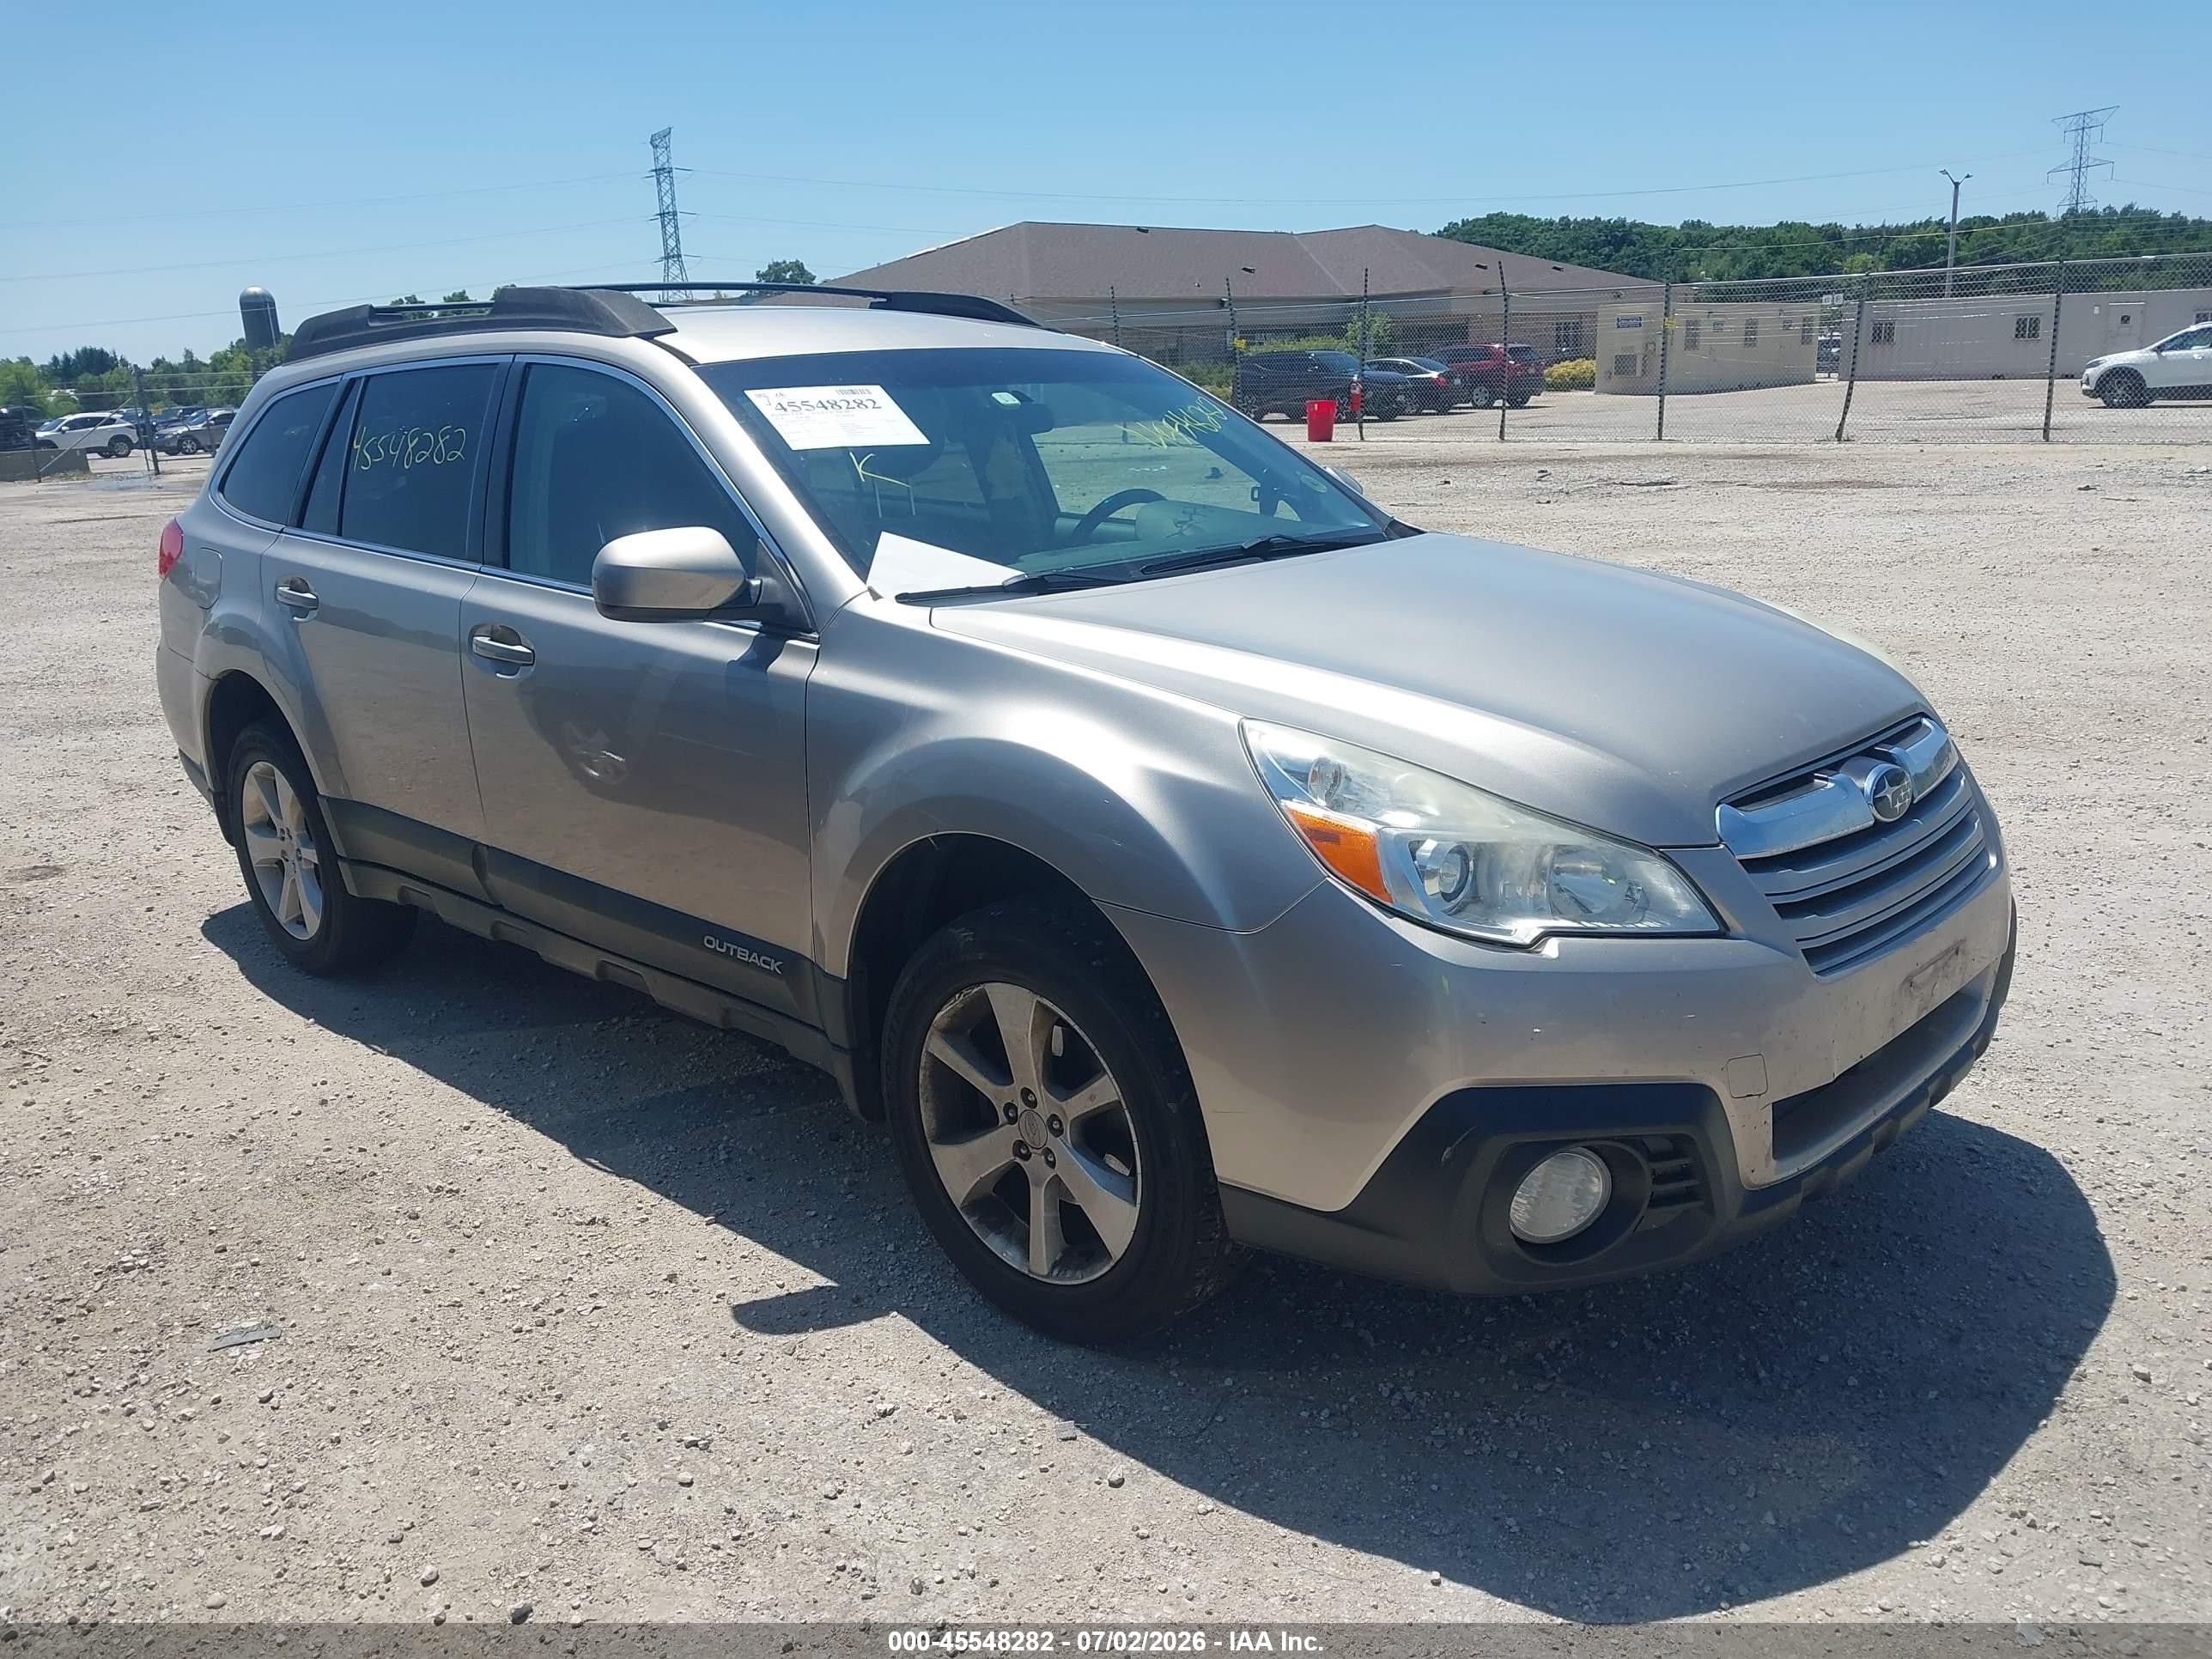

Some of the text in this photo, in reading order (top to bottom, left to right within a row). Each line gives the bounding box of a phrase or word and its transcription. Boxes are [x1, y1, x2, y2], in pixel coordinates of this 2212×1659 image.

[775, 398, 882, 412] 45548282
[353, 425, 466, 471] 45548282
[703, 935, 783, 975] OUTBACK
